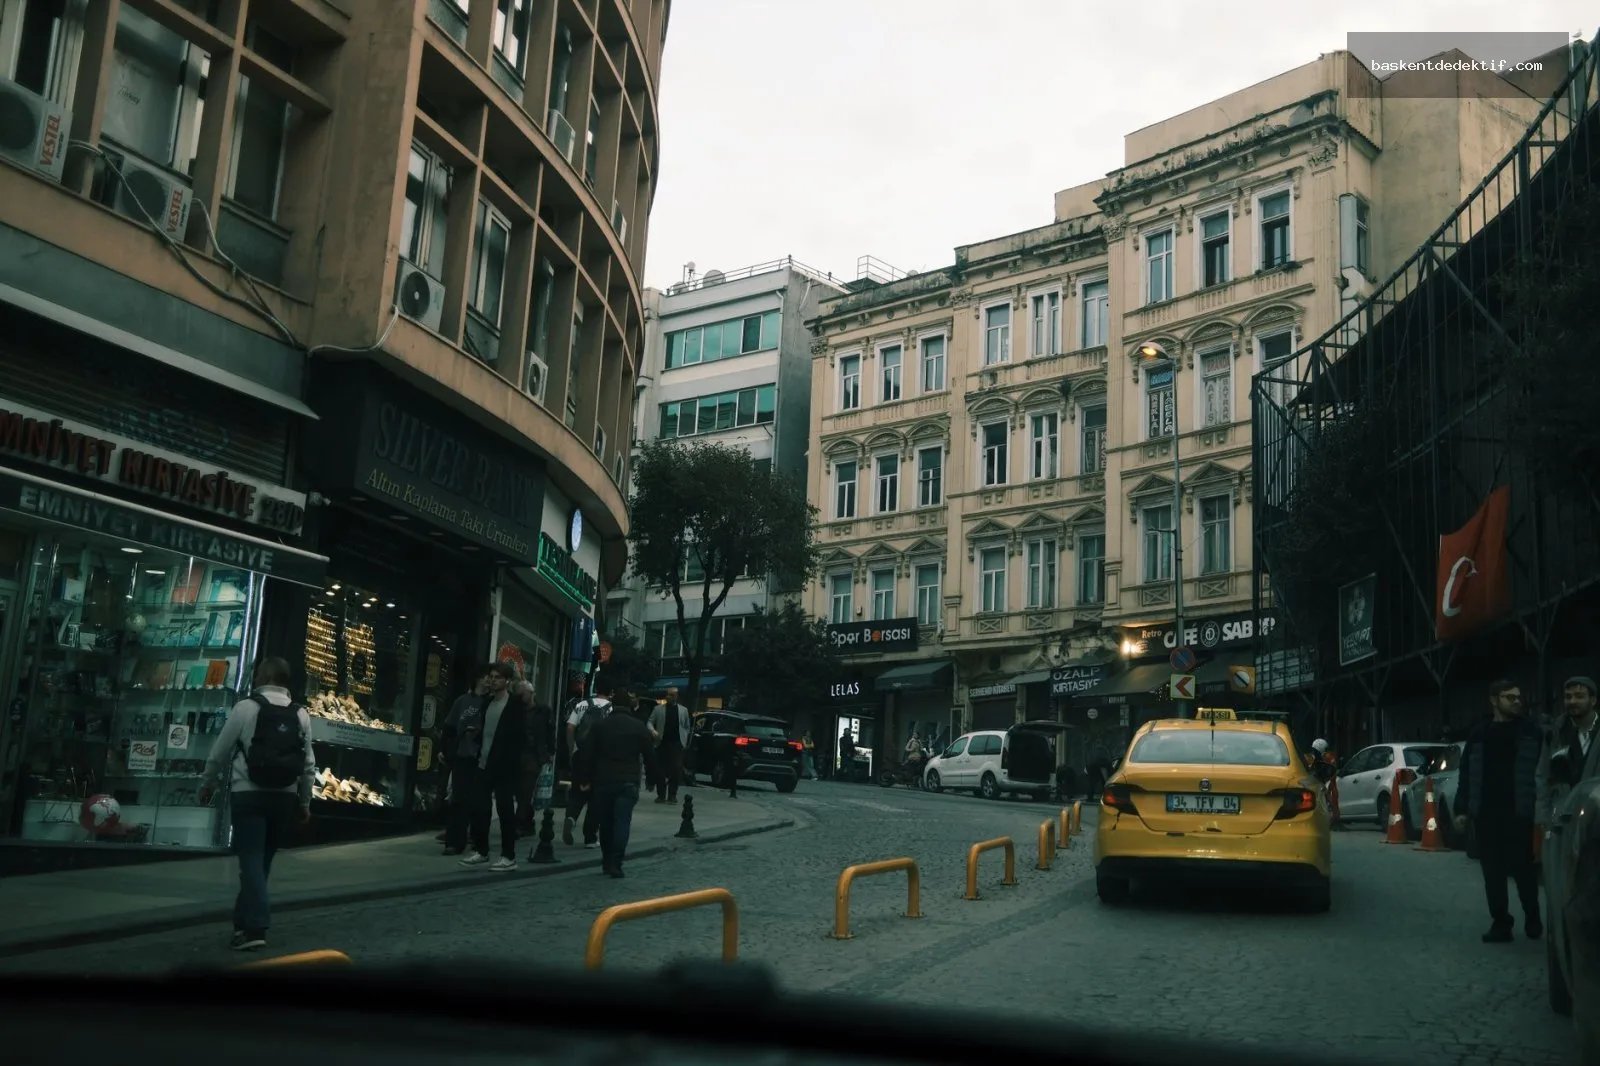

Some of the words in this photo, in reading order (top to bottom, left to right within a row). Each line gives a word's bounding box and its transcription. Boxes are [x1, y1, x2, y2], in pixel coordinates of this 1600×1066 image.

[40, 114, 61, 166] VESTEL
[167, 189, 184, 232] VESTEL
[0, 408, 117, 477] MNİYET
[119, 447, 257, 518] KIRTASİYE
[373, 402, 470, 494] SILVER
[365, 468, 400, 498] Altın
[402, 484, 457, 524] Kaplama
[460, 509, 484, 536] Takı
[864, 627, 911, 643] Borsası
[1141, 629, 1162, 639] Retro
[831, 681, 860, 697] LELAS
[1174, 796, 1187, 808] 34
[1223, 797, 1236, 809] 04
